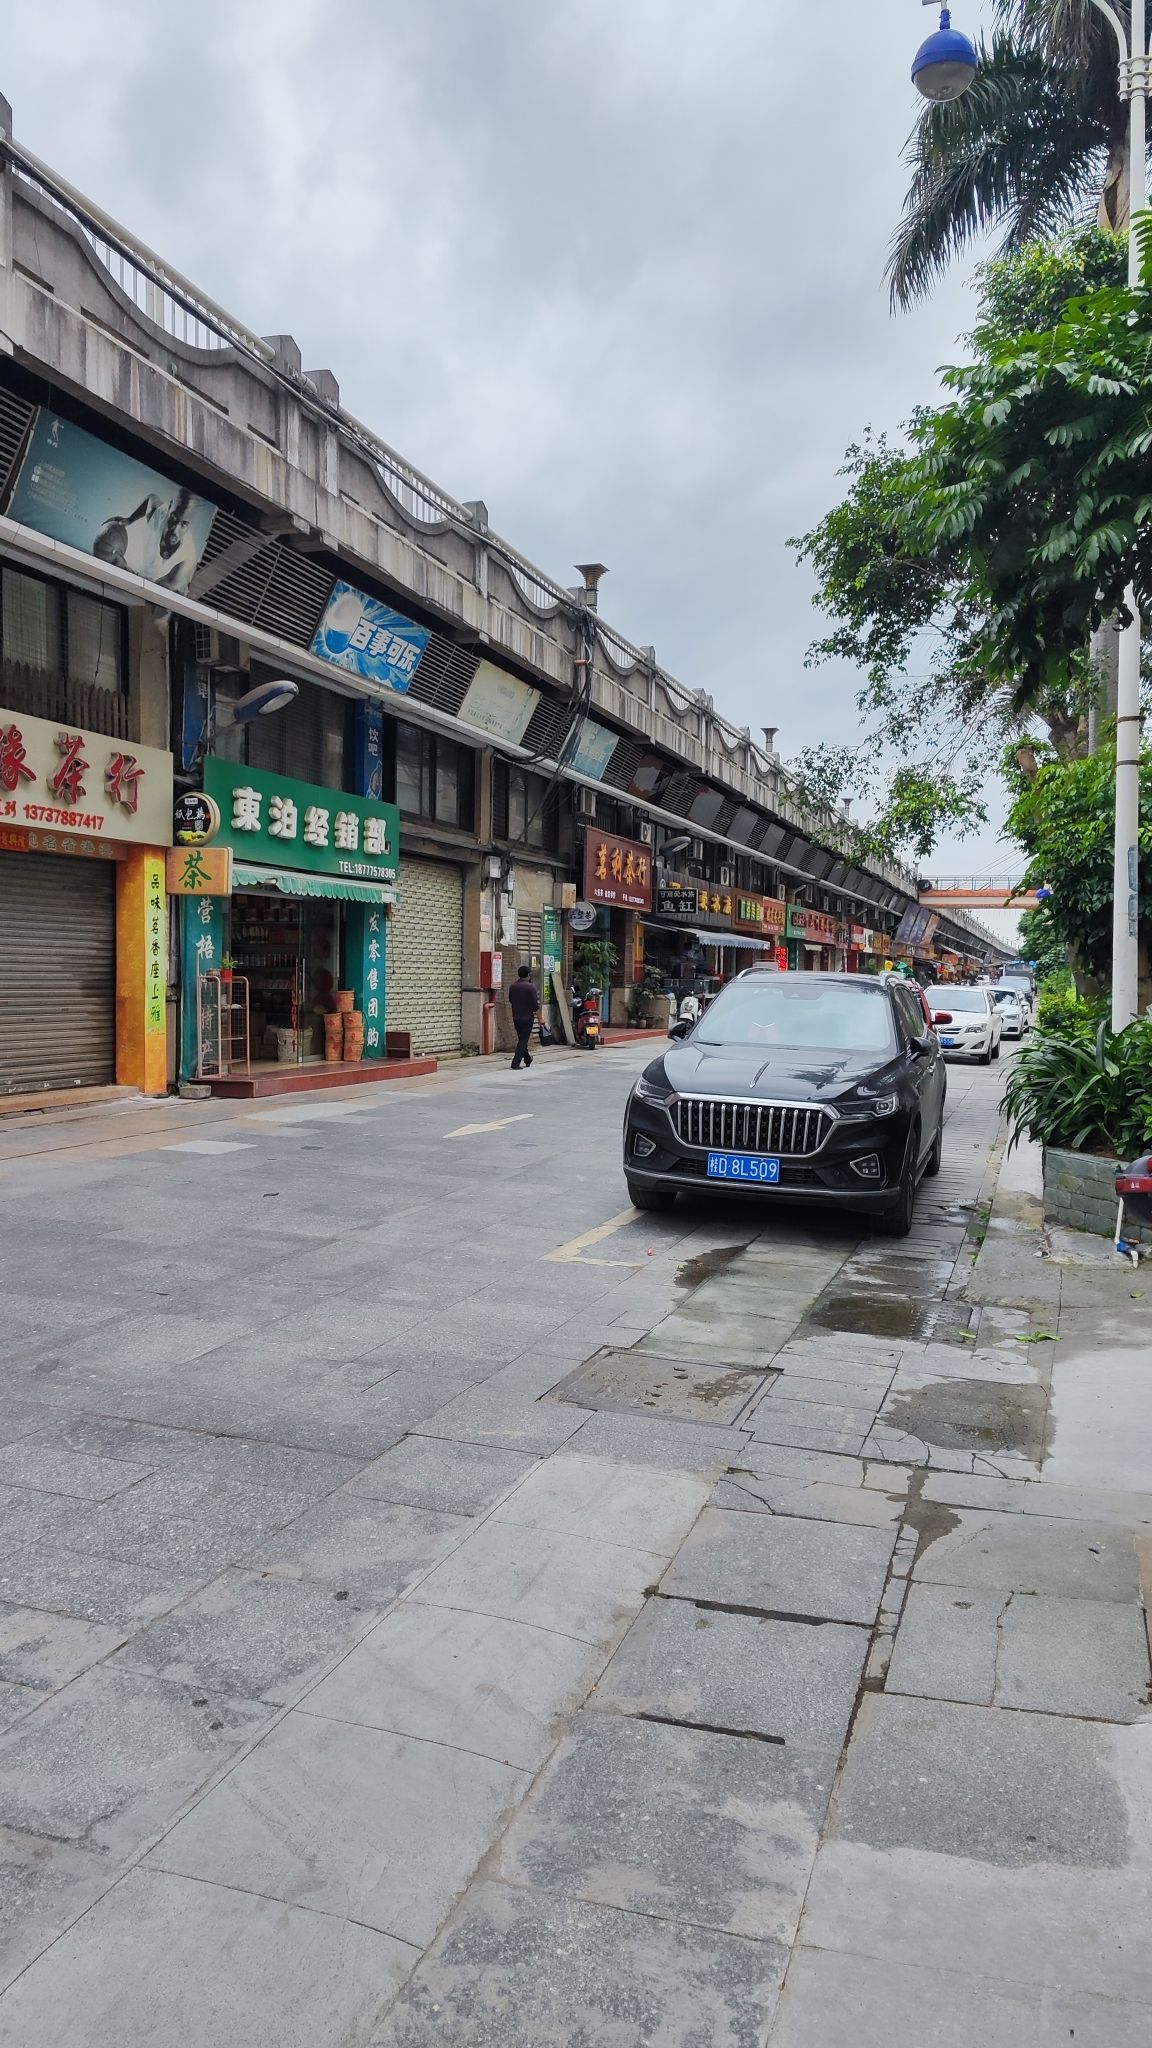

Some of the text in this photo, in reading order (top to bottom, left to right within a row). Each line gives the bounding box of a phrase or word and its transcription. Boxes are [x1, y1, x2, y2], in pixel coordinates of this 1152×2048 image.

[348, 616, 421, 673] 百事可乐
[23, 803, 104, 830] 13737887417
[179, 850, 212, 889] 茶
[660, 900, 695, 912] 鱼缸
